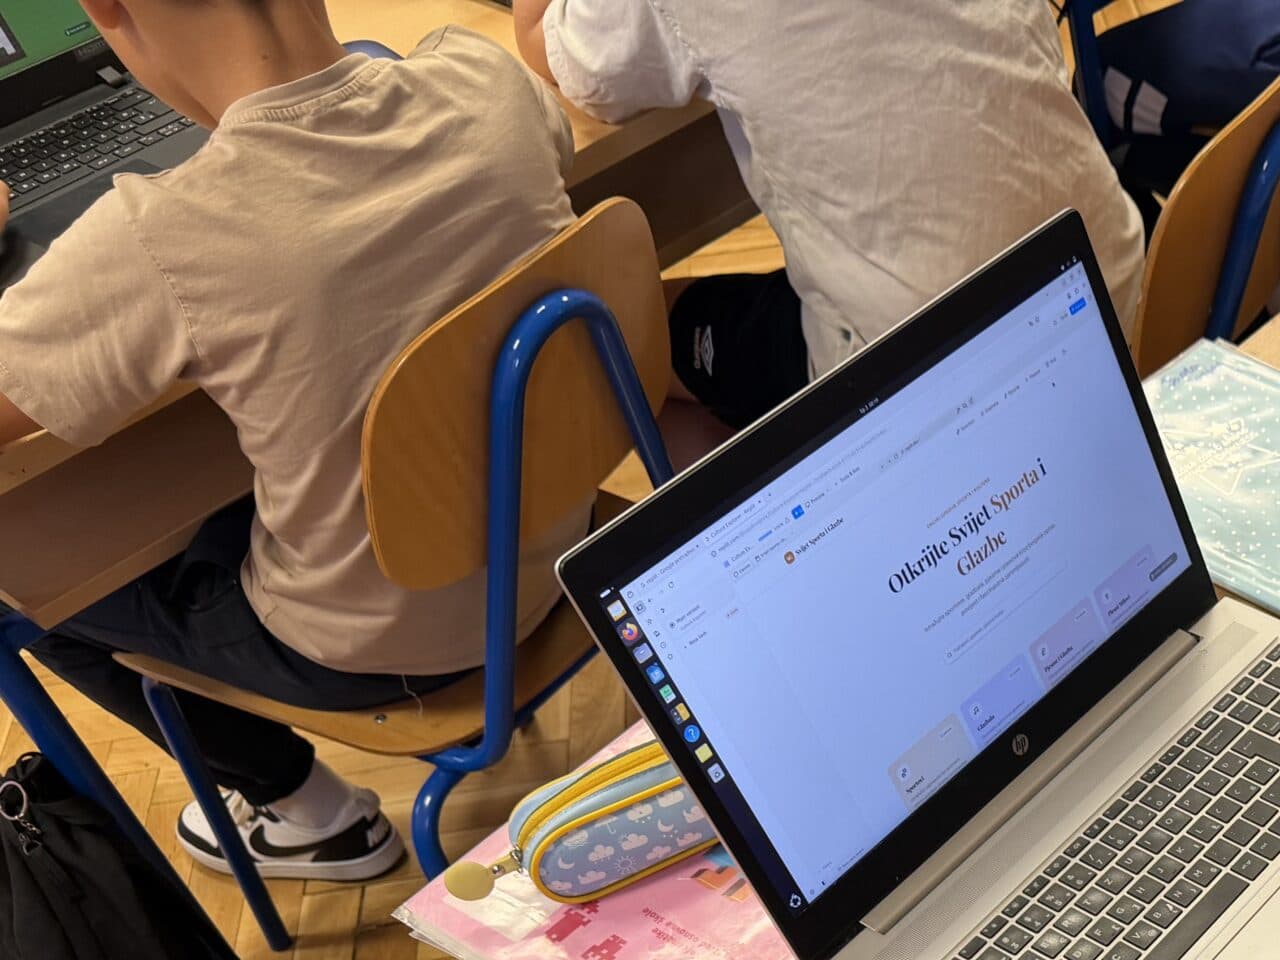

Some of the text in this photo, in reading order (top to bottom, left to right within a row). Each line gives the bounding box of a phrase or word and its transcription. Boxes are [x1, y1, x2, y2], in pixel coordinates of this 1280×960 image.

[794, 541, 809, 556] Svijet
[807, 529, 825, 547] Sporta
[827, 515, 844, 532] Glazbe
[888, 541, 948, 592] Otkrijte
[948, 505, 990, 546] Svijet
[990, 469, 1039, 513] Sporta
[1036, 457, 1046, 475] i
[957, 531, 1006, 575] Glazbe
[641, 906, 664, 926] škole
